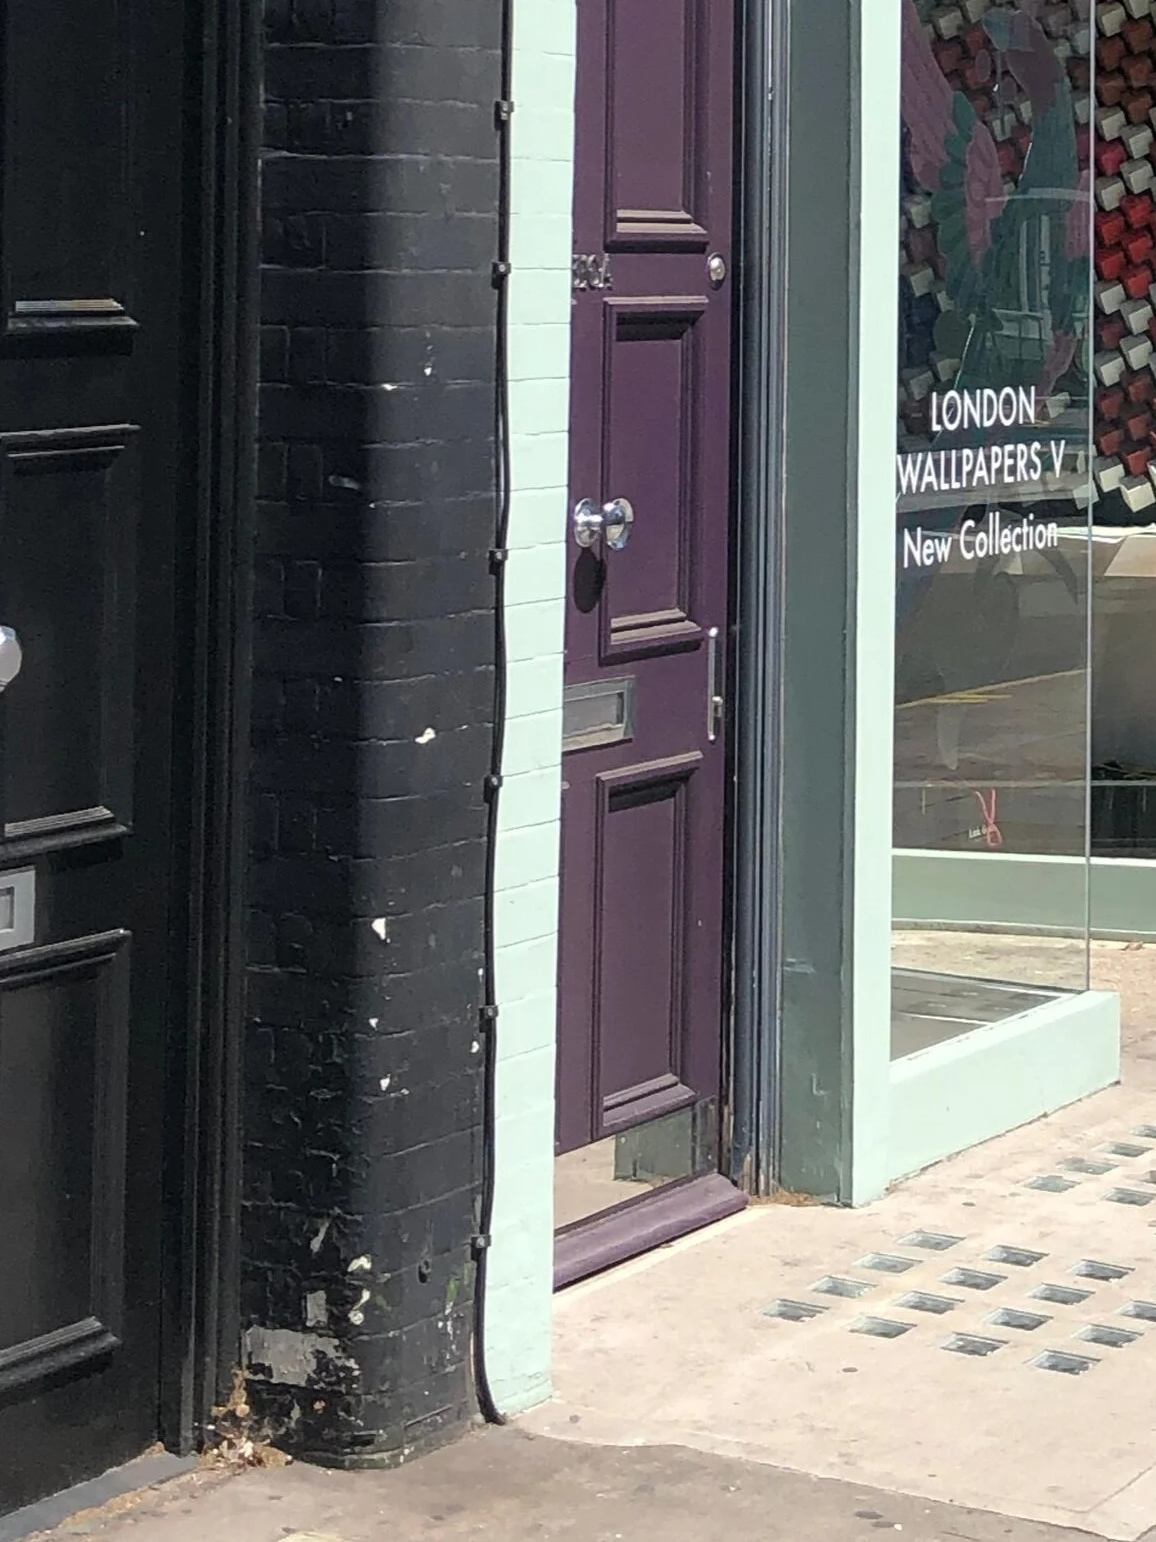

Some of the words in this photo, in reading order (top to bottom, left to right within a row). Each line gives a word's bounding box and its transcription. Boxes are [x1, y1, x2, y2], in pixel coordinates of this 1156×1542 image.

[931, 386, 1036, 432] LONDON
[897, 441, 1042, 495] WALLPAPERS
[1050, 440, 1066, 479] V
[904, 527, 952, 569] New
[959, 511, 1058, 560] Collection
